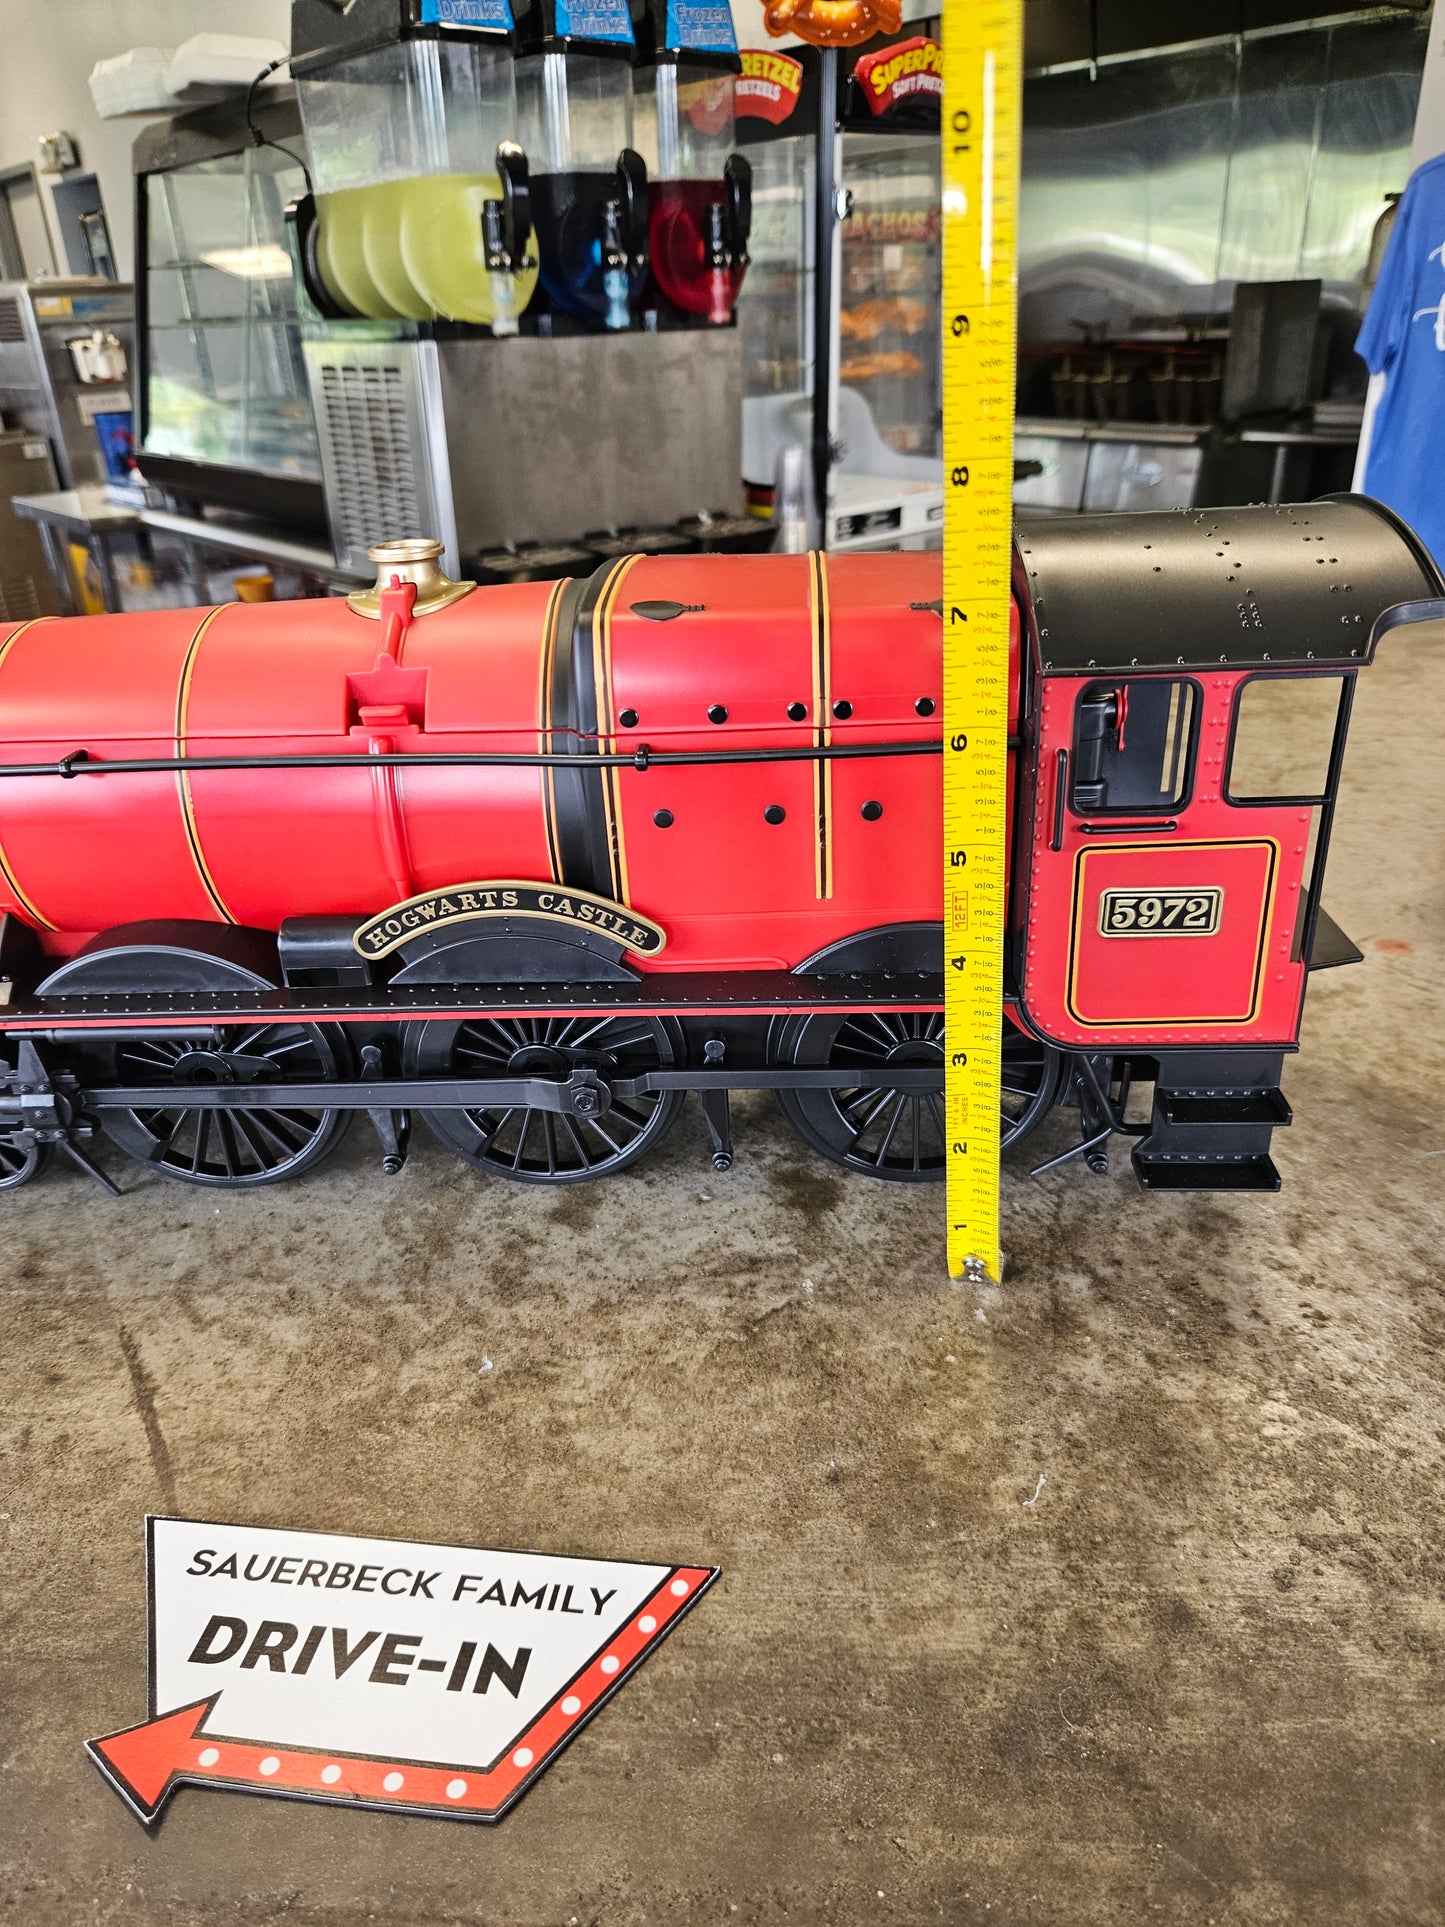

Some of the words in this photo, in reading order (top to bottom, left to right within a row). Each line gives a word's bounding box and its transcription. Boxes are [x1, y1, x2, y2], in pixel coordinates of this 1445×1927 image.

[438, 0, 507, 20] Drinks
[674, 3, 730, 25] Frozen
[571, 11, 629, 35] Drinks
[679, 23, 734, 47] Drinks
[952, 110, 971, 154] 10
[952, 314, 970, 338] 9
[951, 466, 969, 487] 8
[951, 606, 968, 625] 7
[951, 733, 968, 752] 6
[950, 850, 967, 867] 5
[365, 889, 518, 949] HOGWARTS
[538, 893, 649, 947] CASTLE
[1111, 898, 1209, 929] 5972
[951, 955, 967, 970] 4
[952, 1052, 967, 1067] 3
[952, 1142, 967, 1154] 2
[186, 1549, 443, 1599] SAUERBECK
[452, 1574, 618, 1616] FAMILY
[187, 1614, 533, 1699] DRIVE-IN
